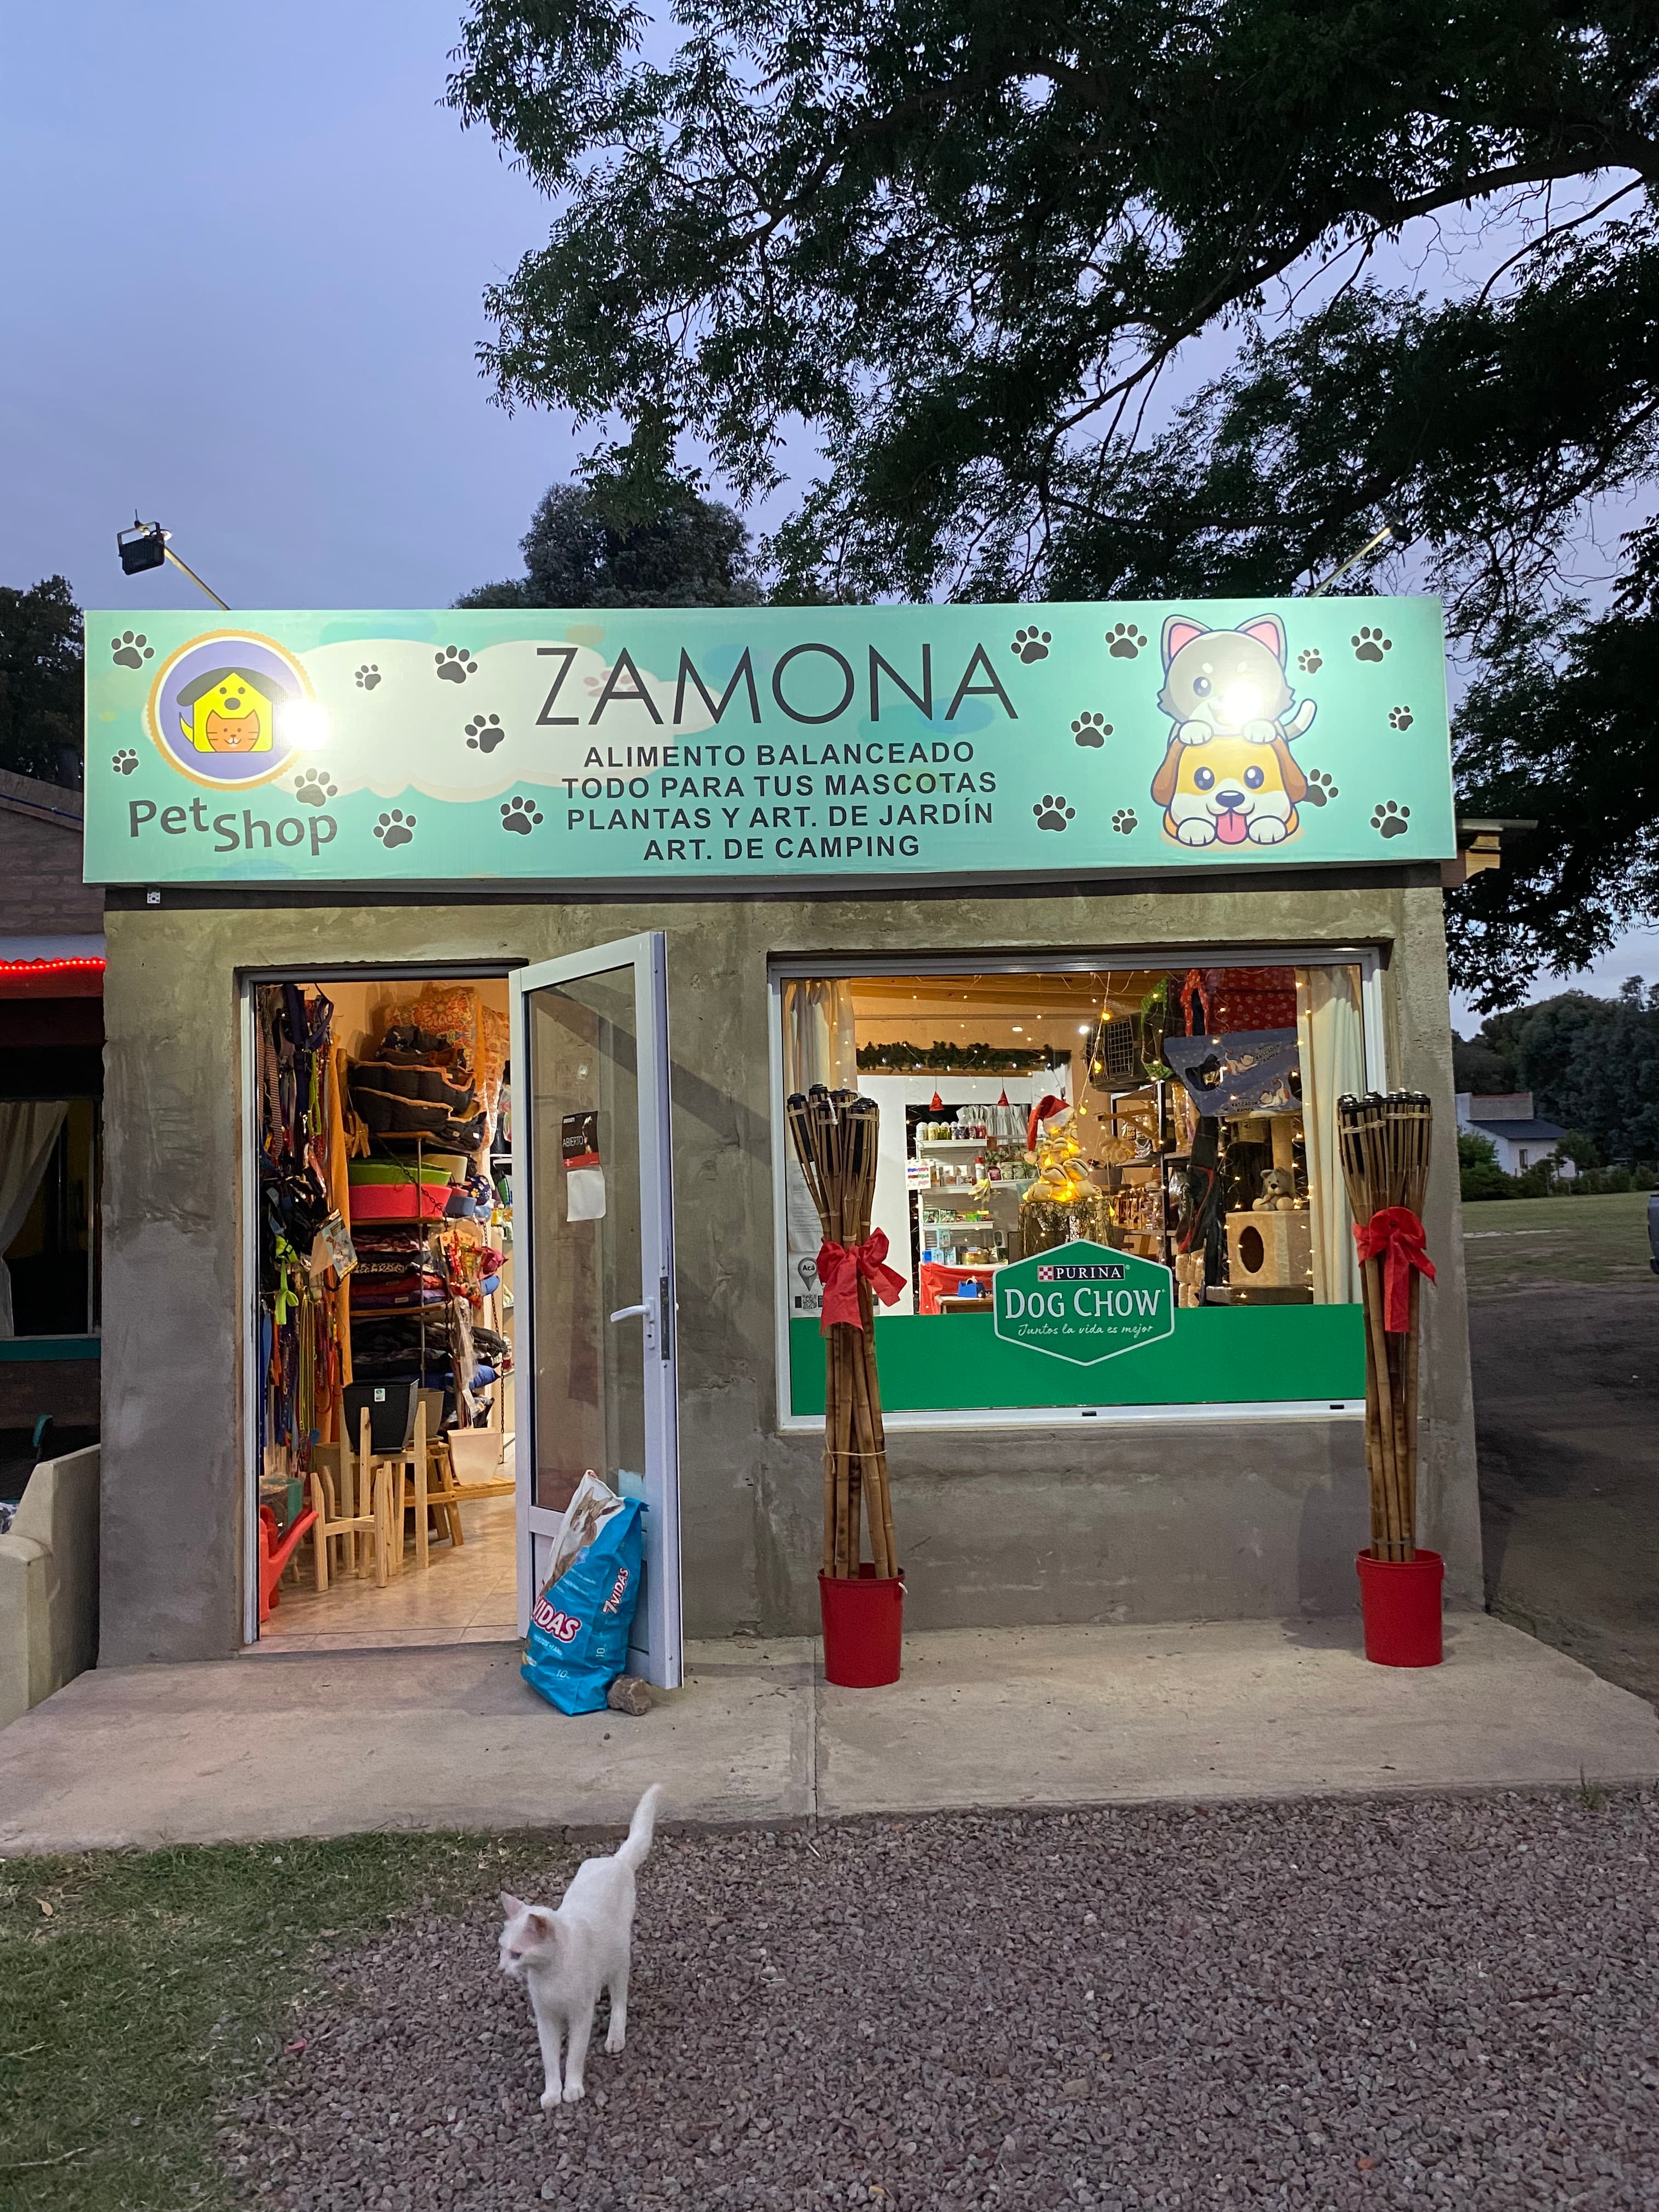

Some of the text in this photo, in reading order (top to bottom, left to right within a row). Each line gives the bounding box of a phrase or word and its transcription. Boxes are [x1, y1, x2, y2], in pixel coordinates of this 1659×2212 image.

[535, 643, 1019, 725] ZAMONA
[584, 741, 973, 767] ALIMENTO BALANCEADO
[562, 772, 996, 799] TODO PARA TUS MASCOTAS
[568, 797, 992, 830] PLANTAS Y ART. DE JARDÍN
[643, 835, 919, 861] ART. DE CAMPING
[562, 1136, 584, 1147] ABIERTO
[1056, 1266, 1122, 1279] PURINA
[1004, 1287, 1161, 1319] DOG CHOW
[1018, 1323, 1058, 1336] Juntos
[1062, 1324, 1075, 1334] la
[1079, 1323, 1104, 1334] vida
[1121, 1323, 1154, 1338] mejor
